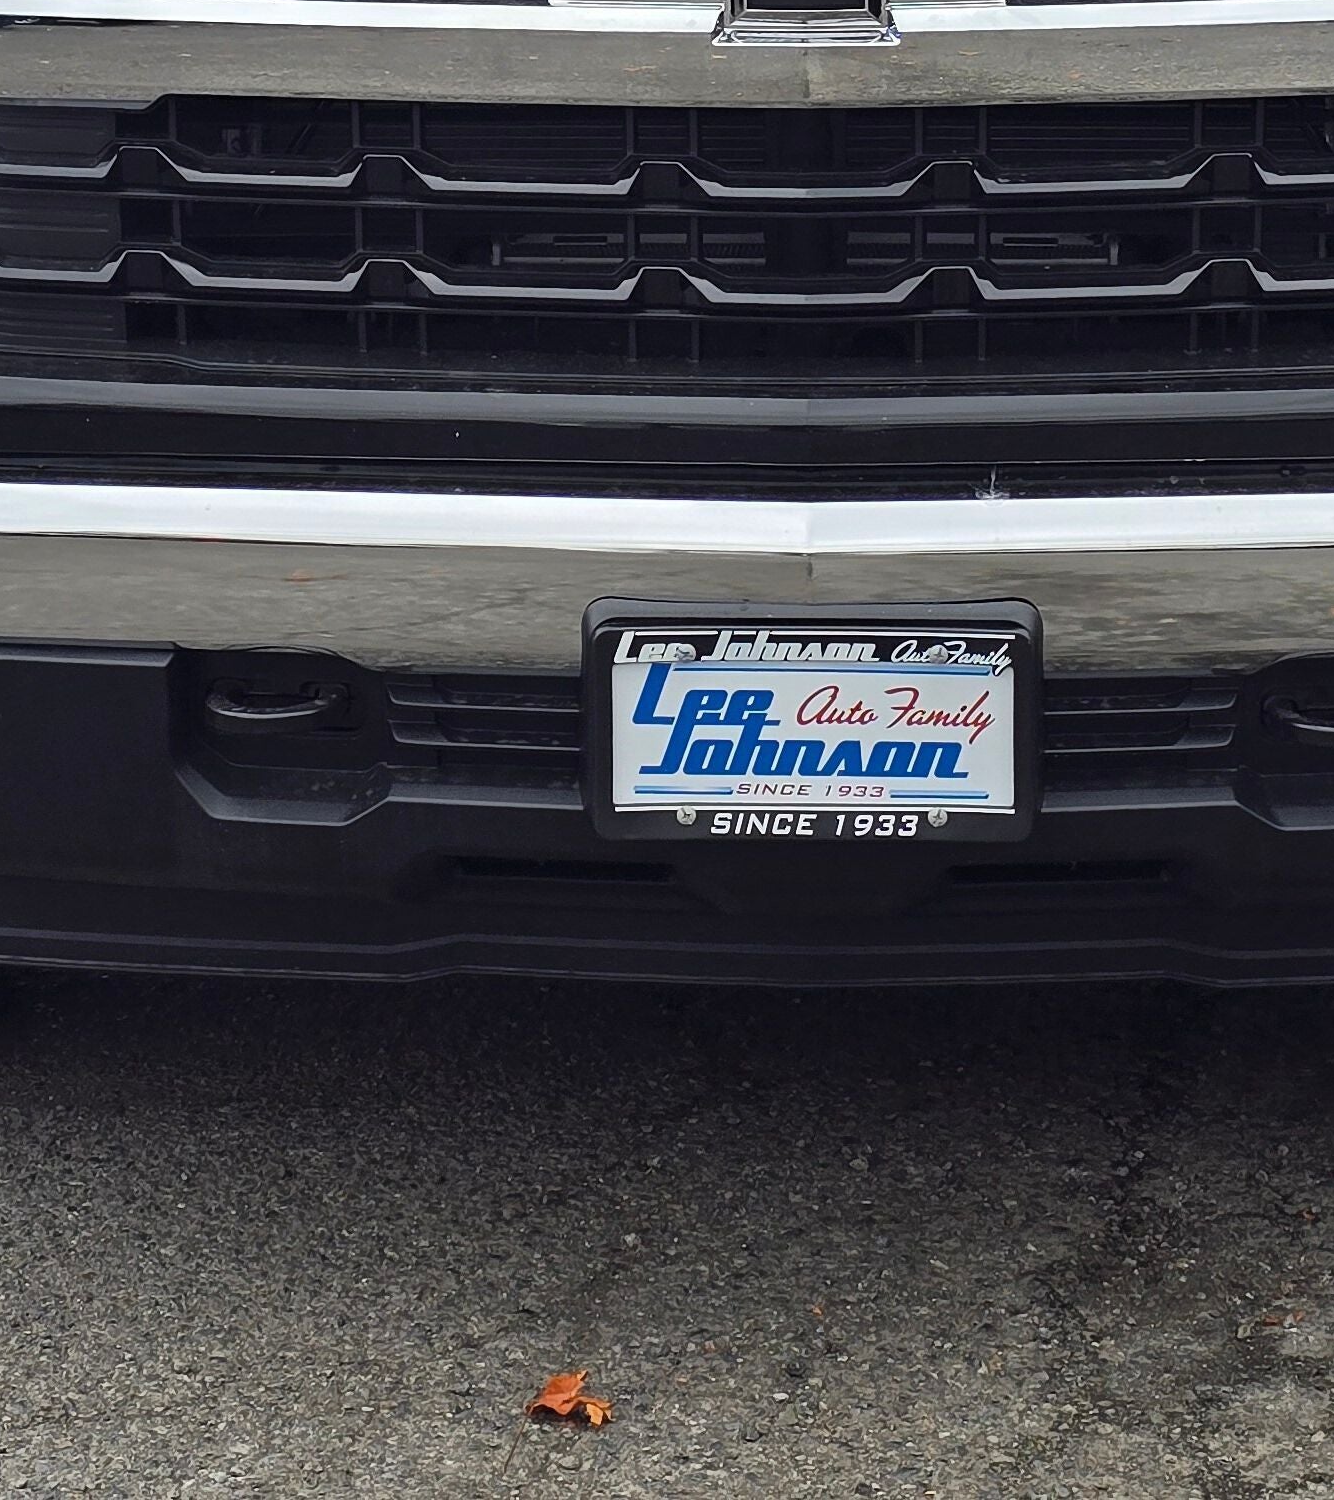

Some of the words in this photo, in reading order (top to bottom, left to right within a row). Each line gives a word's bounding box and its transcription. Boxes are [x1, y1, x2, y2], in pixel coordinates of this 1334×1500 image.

[701, 630, 880, 662] Johnson
[890, 640, 948, 663] Aut
[943, 640, 1013, 676] Family
[632, 662, 782, 726] Lee
[796, 685, 878, 726] Auto
[883, 686, 996, 745] Family
[639, 714, 969, 779] Johnson
[736, 782, 812, 797] SINCE
[824, 783, 885, 798] 1933
[710, 812, 817, 835] SINCE
[834, 813, 918, 837] 1933
